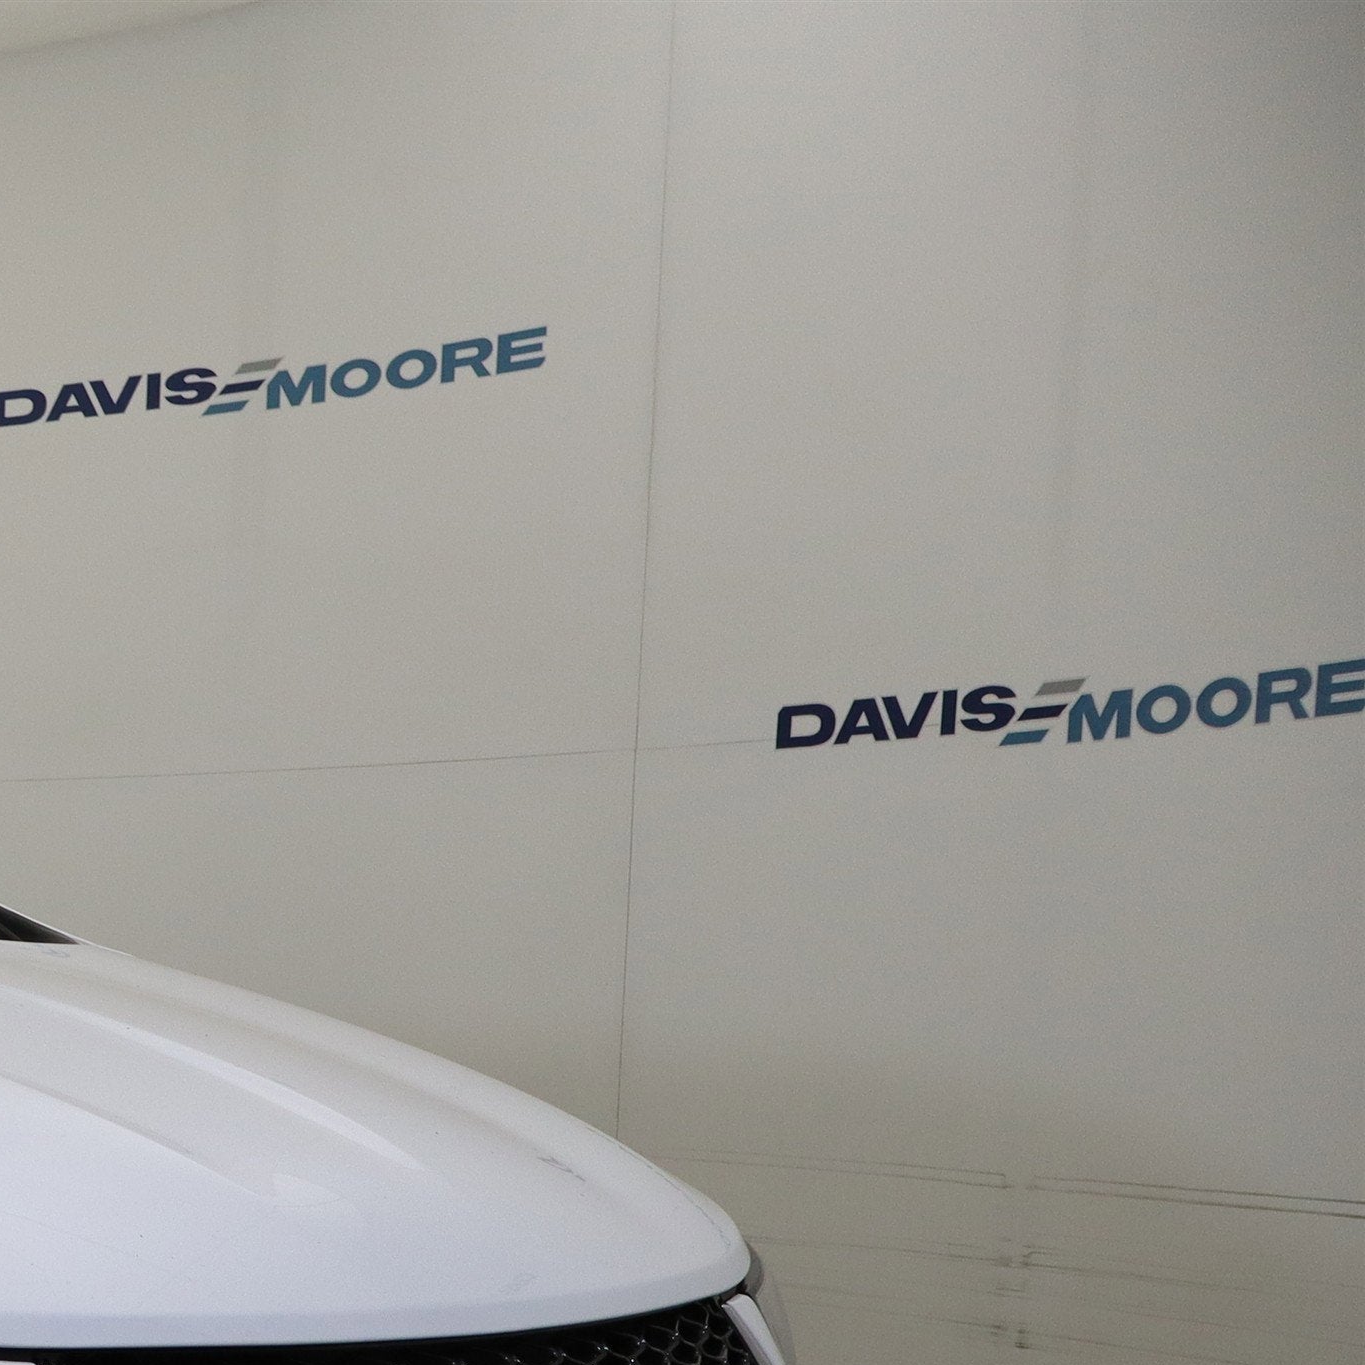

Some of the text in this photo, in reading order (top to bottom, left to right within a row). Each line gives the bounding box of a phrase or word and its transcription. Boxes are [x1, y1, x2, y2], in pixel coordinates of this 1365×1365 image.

[265, 326, 548, 410] MOORE
[775, 658, 1365, 750] DAVIS MOORE
